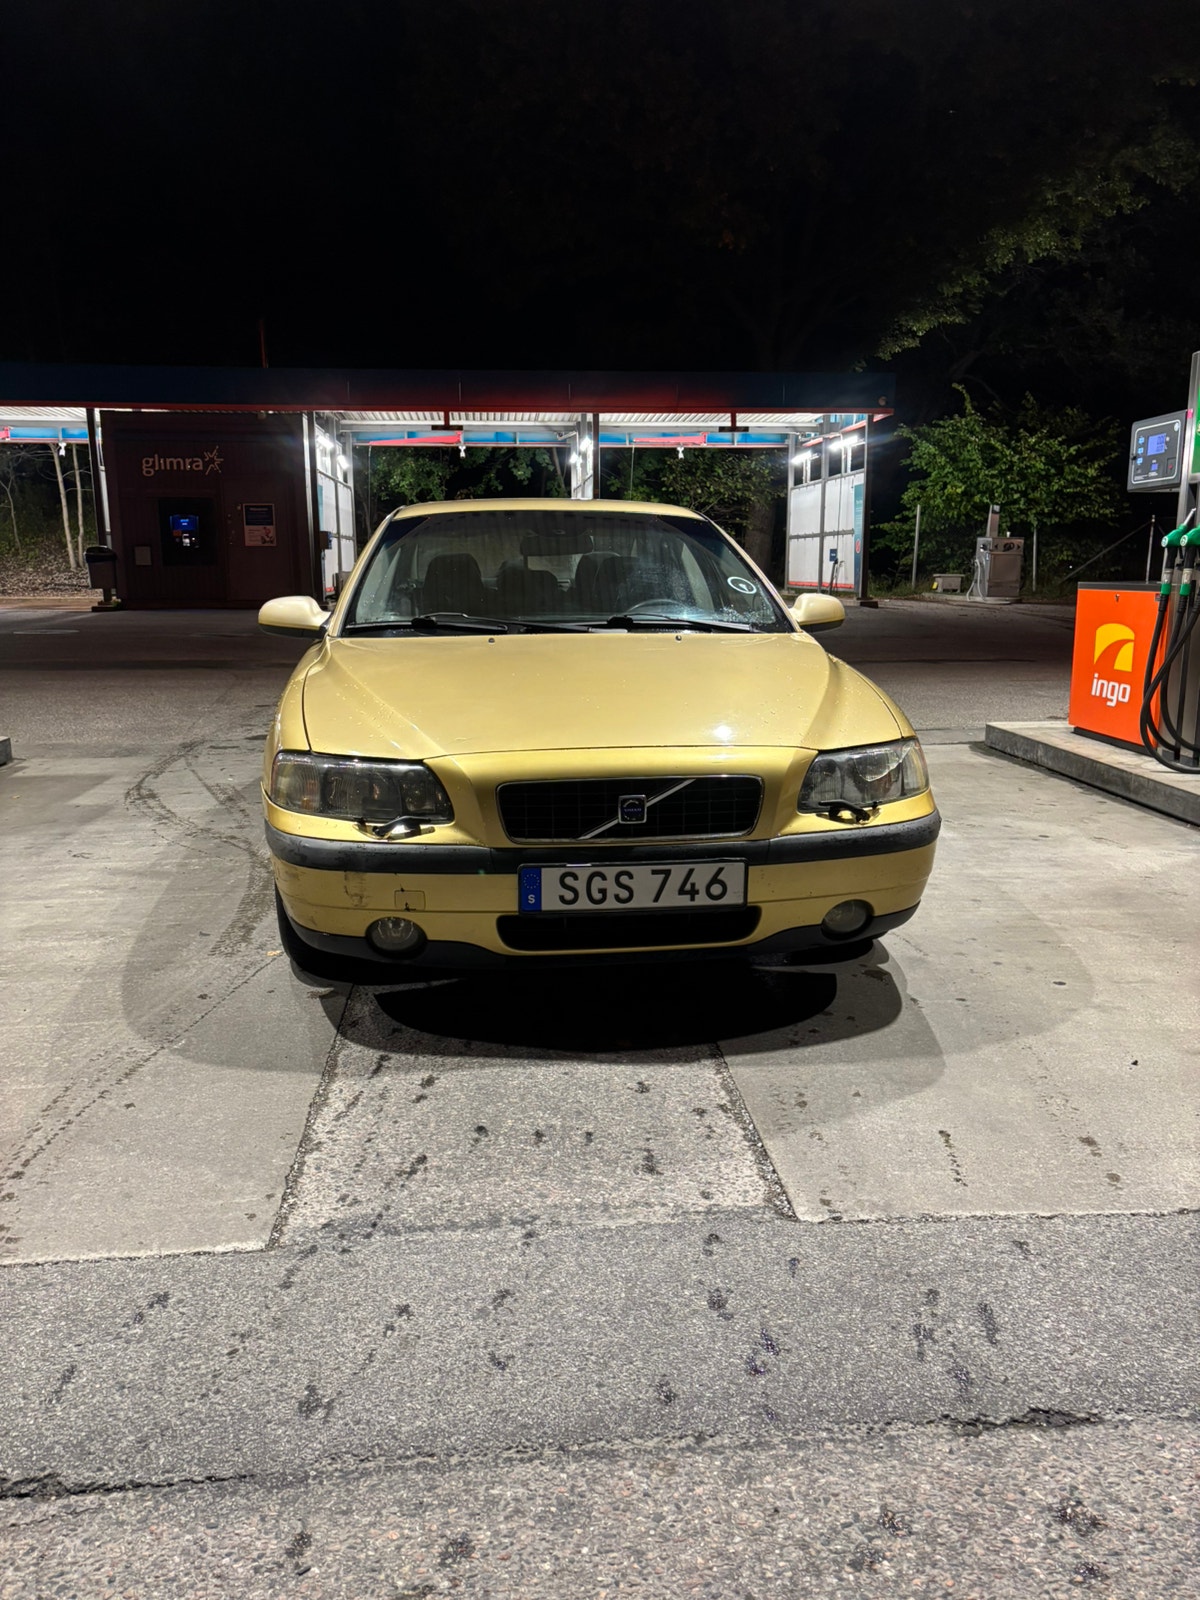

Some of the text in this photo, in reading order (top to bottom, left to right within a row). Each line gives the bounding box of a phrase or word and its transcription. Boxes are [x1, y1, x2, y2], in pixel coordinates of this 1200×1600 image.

[142, 453, 203, 477] glimra
[1091, 672, 1131, 707] ingo
[527, 894, 535, 904] S
[558, 867, 728, 905] SGS 746
